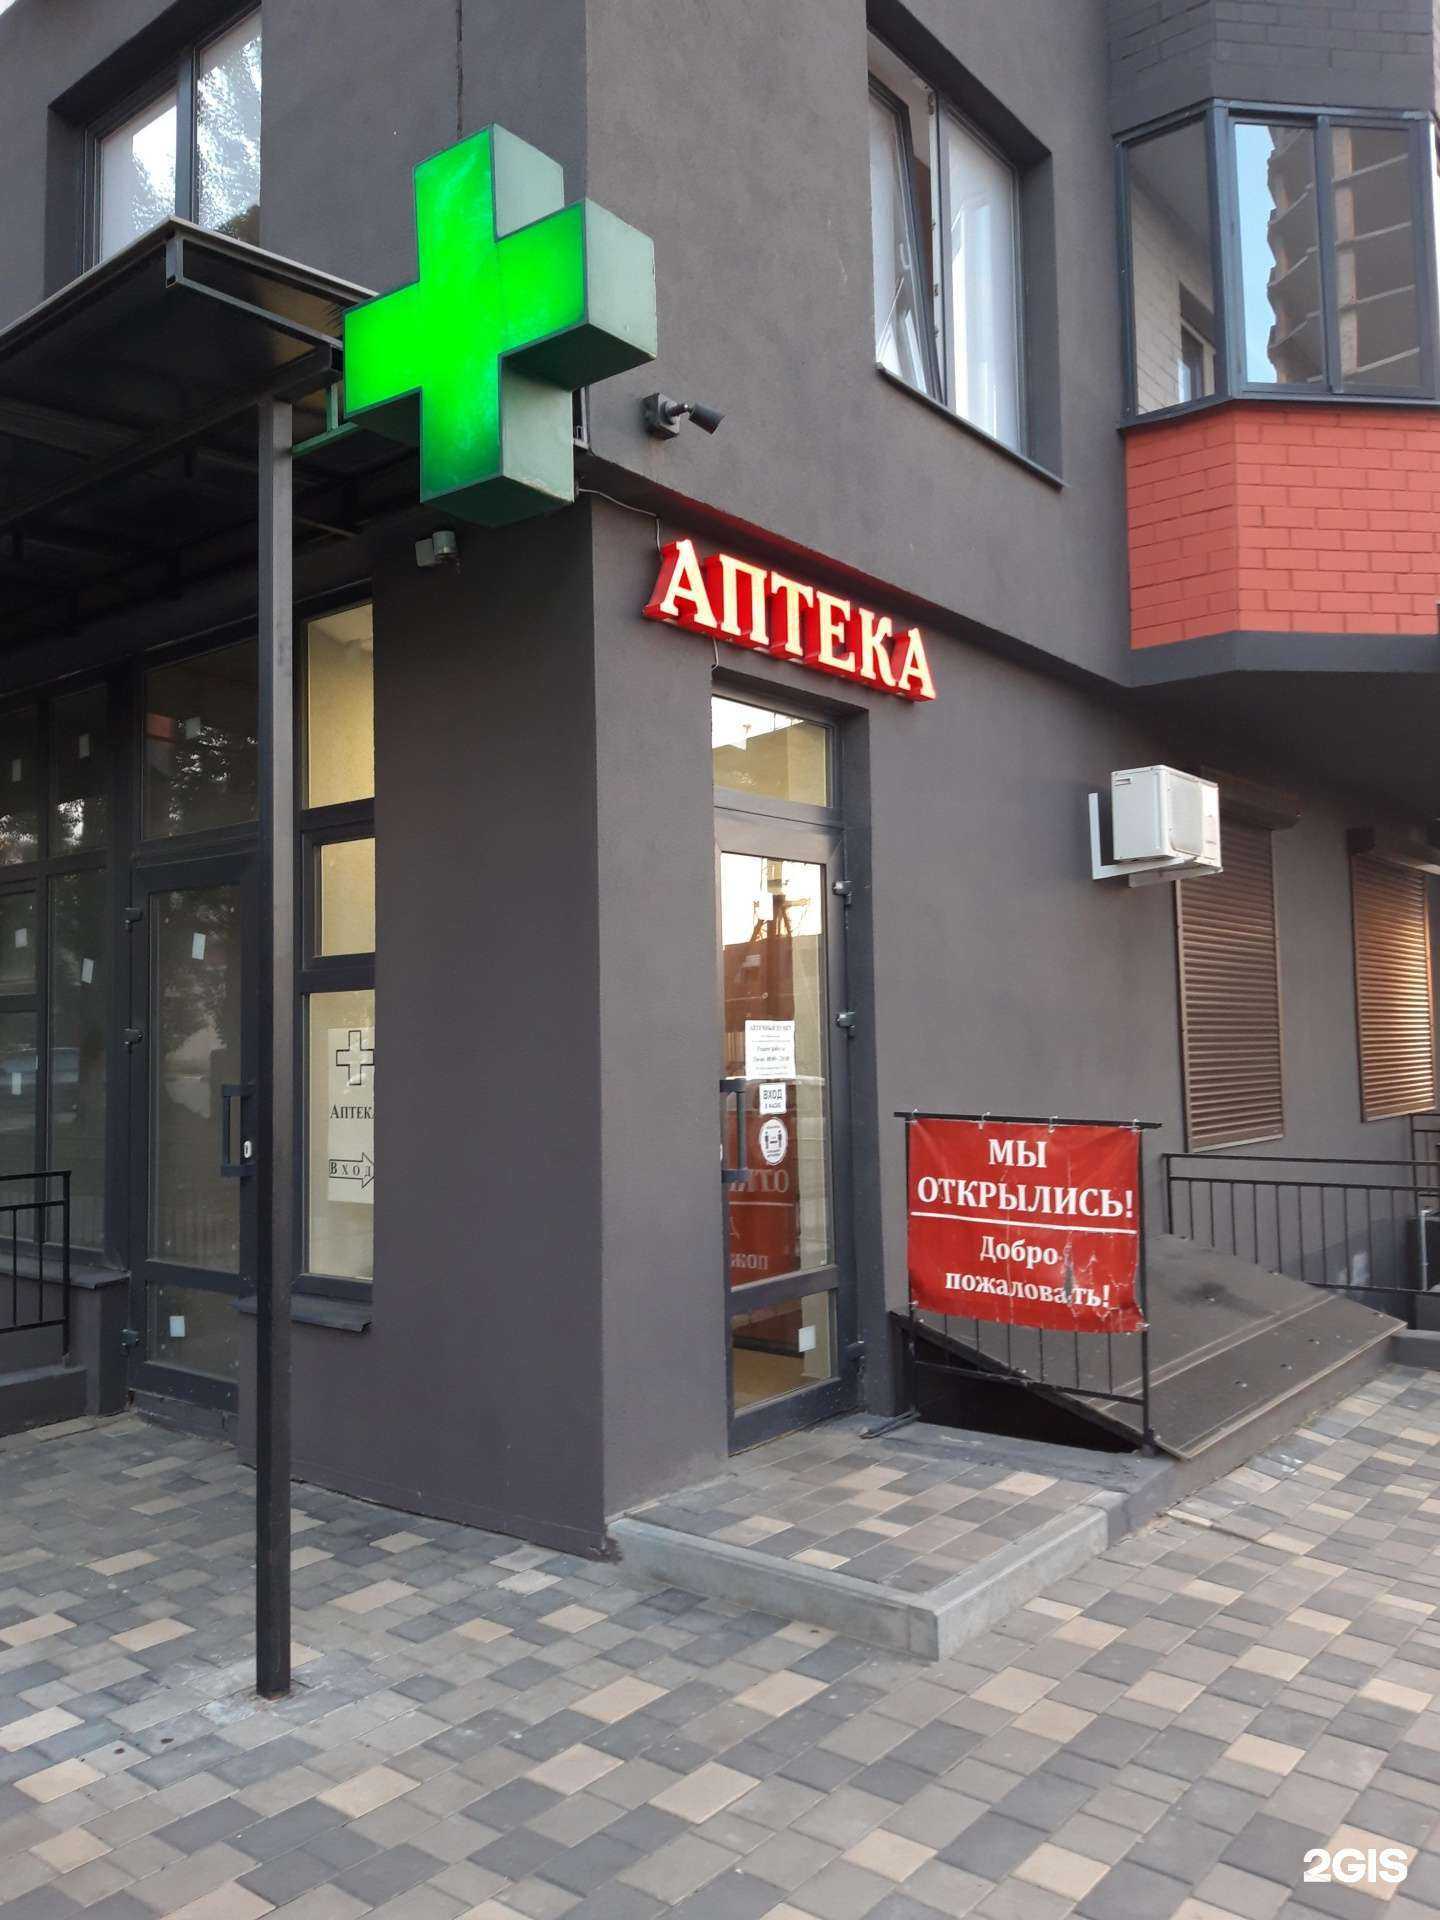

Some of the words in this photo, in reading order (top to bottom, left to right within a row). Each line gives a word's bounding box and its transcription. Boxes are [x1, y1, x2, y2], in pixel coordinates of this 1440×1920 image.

[656, 538, 937, 700] АПТЕКА
[988, 1138, 1048, 1168] МЫ
[917, 1176, 1134, 1218] ОТКРЫЛИСЬ!
[980, 1236, 1060, 1270] Добро
[945, 1272, 1110, 1309] пожаловать!
